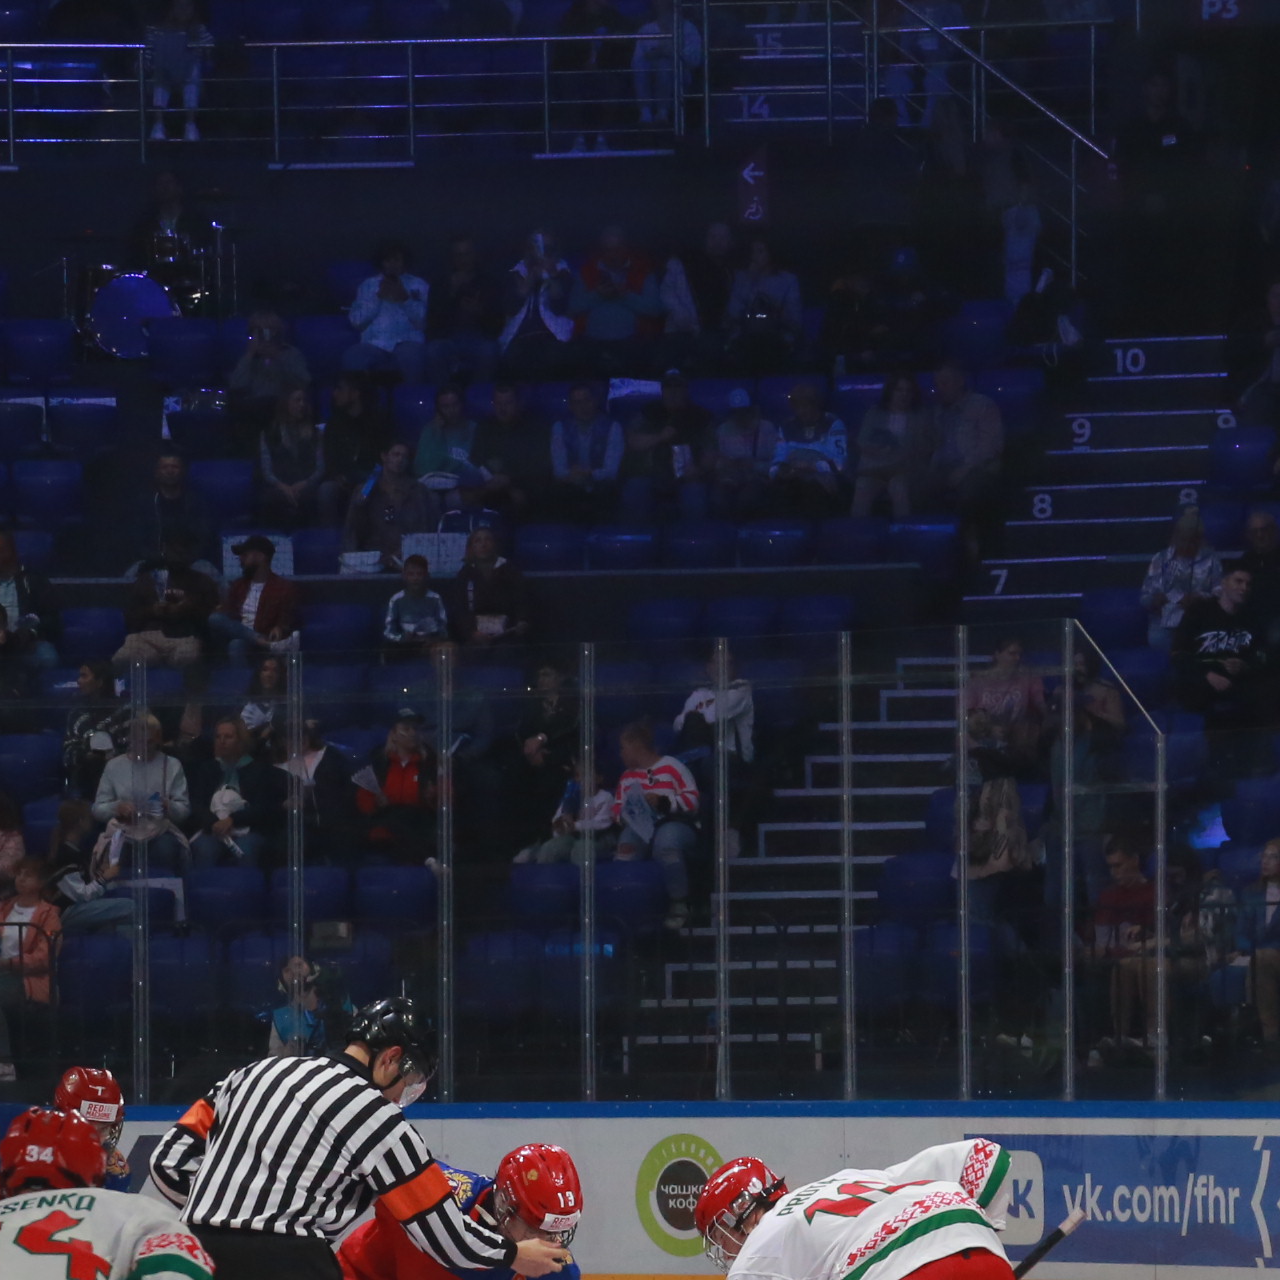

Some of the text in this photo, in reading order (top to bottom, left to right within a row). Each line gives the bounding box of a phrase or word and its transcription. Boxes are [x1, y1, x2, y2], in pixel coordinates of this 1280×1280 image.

[1113, 347, 1147, 374] 10
[1072, 417, 1091, 443] 9
[1032, 493, 1052, 519] 8
[989, 568, 1009, 595] 7
[24, 1144, 55, 1165] 34
[557, 1190, 576, 1208] 13
[1062, 1173, 1241, 1236] vk.com/fhr
